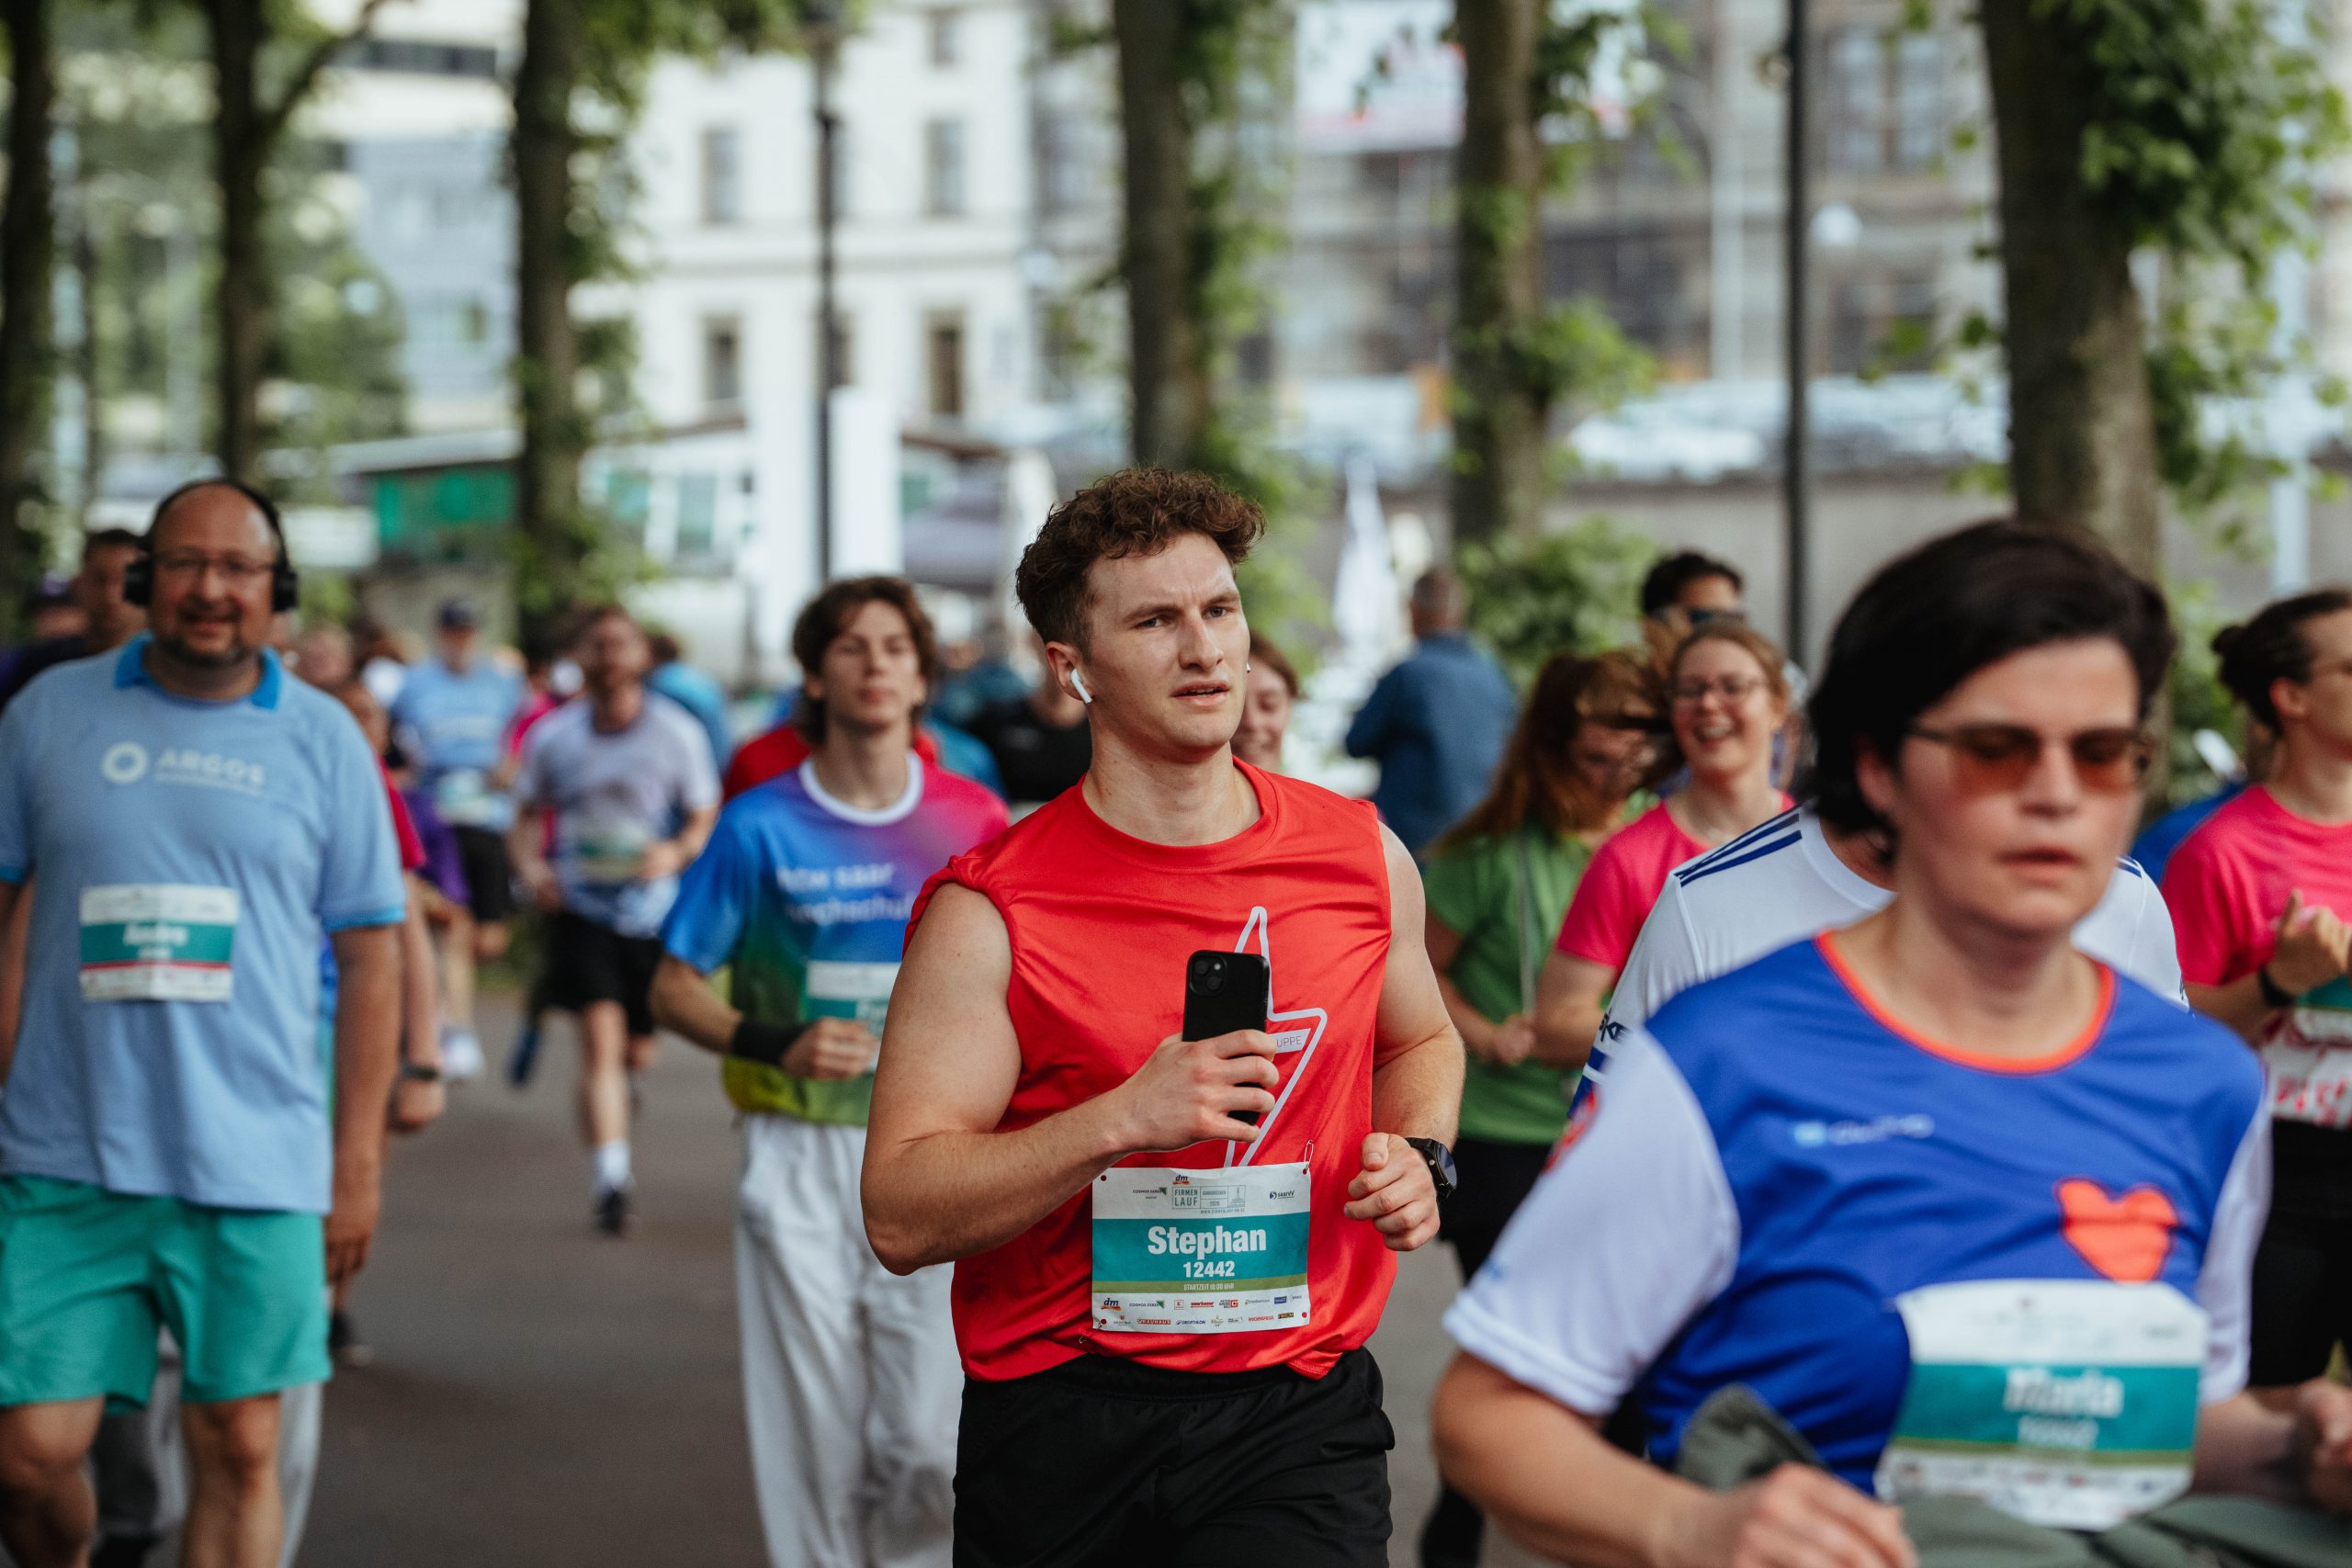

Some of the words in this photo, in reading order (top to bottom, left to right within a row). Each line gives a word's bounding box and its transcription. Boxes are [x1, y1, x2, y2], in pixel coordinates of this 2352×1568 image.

[156, 748, 266, 784] ARGOS
[1174, 1197, 1197, 1207] LAUF
[1148, 1224, 1267, 1260] Stephan
[1183, 1260, 1236, 1278] 12442
[1103, 1297, 1119, 1307] dm
